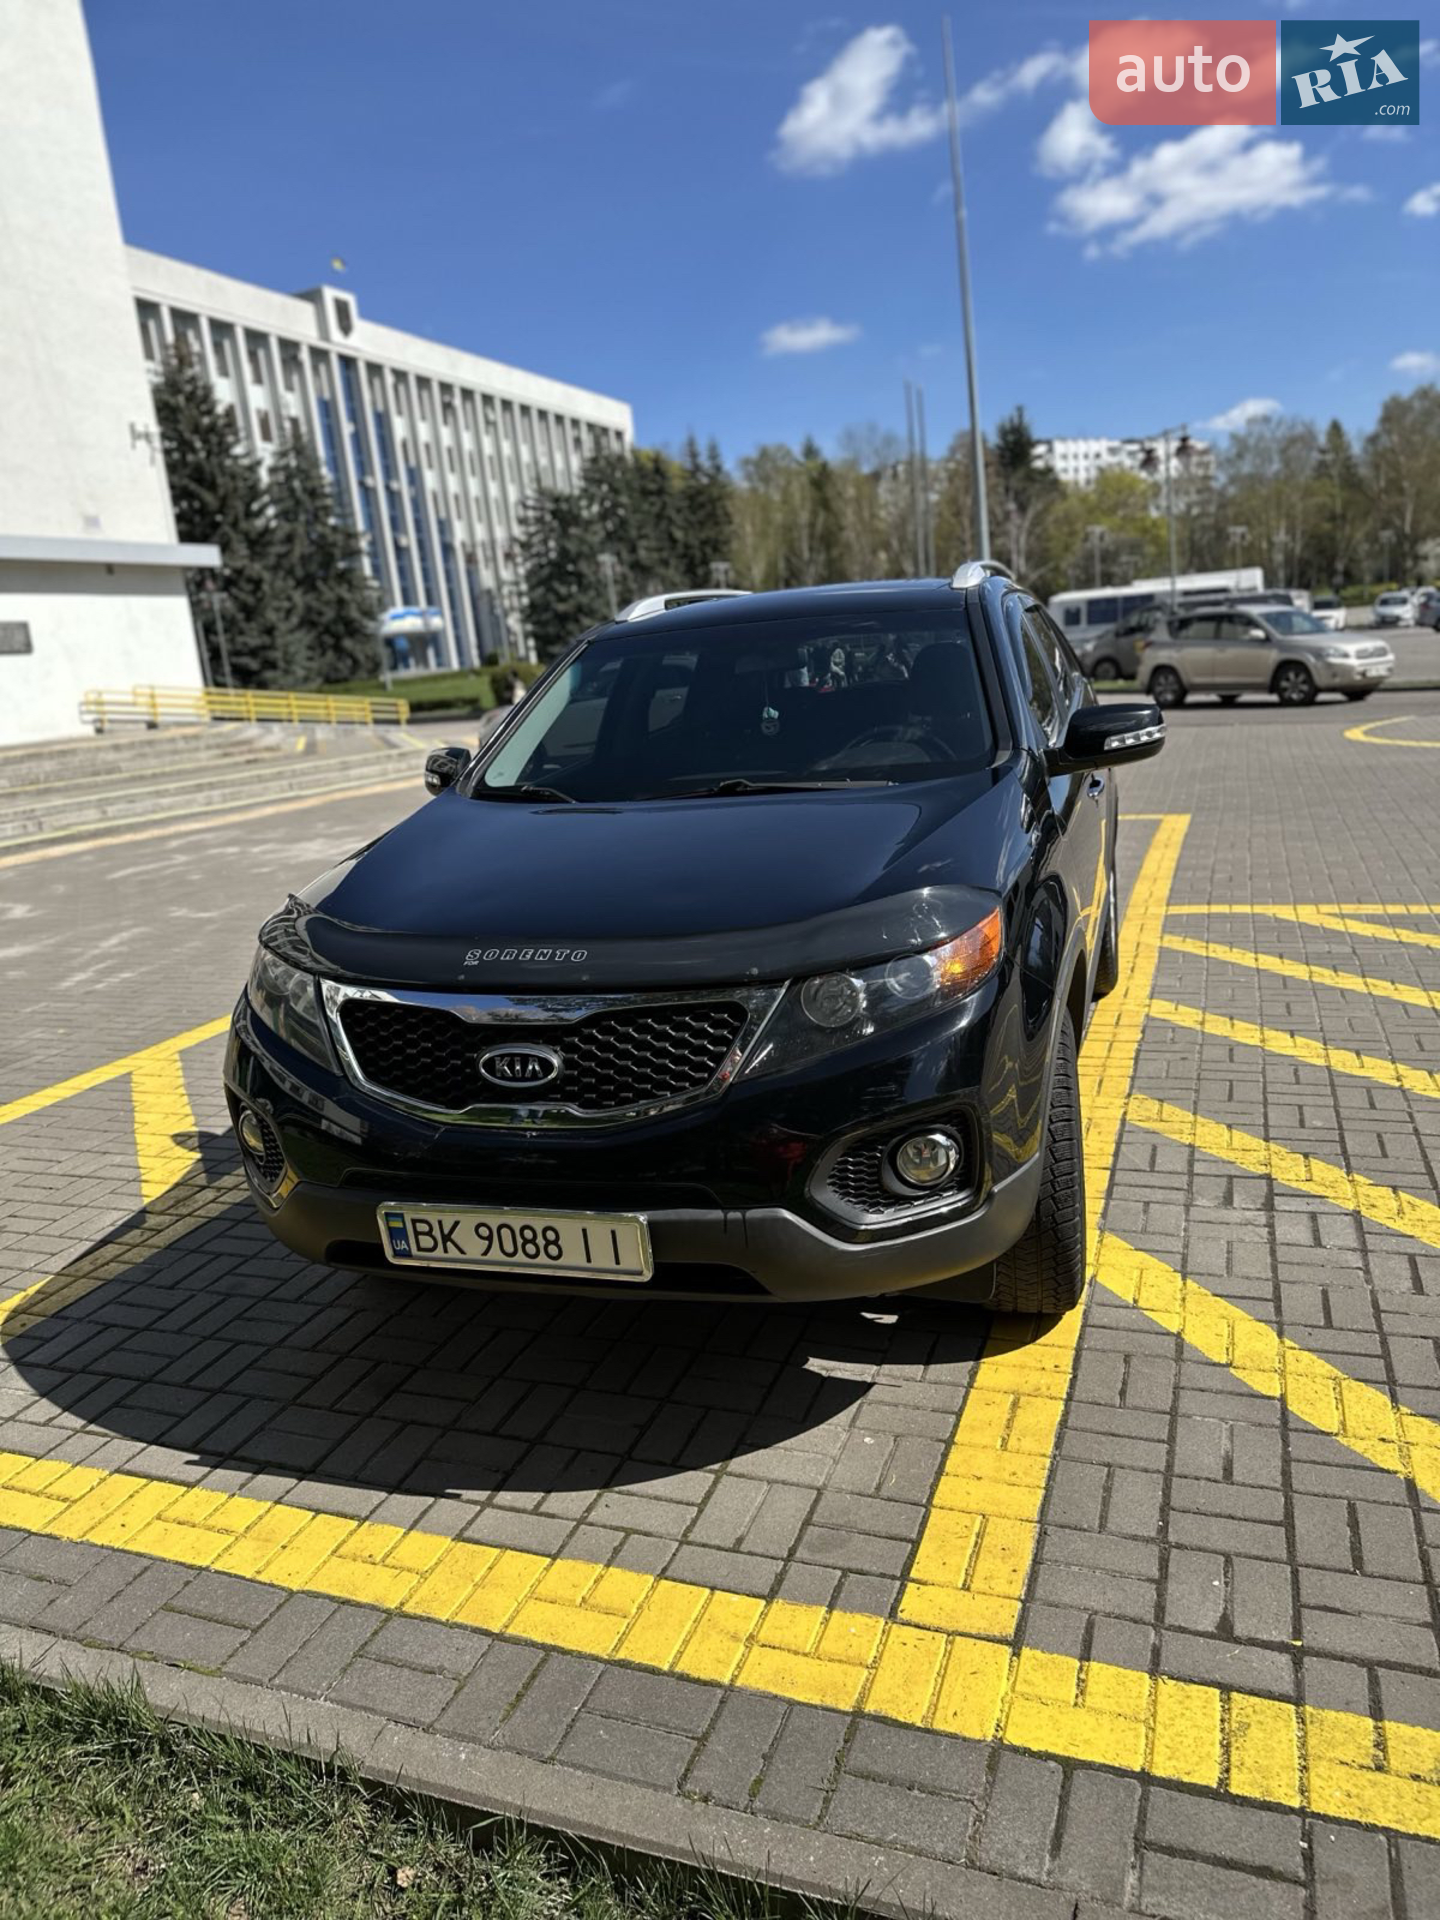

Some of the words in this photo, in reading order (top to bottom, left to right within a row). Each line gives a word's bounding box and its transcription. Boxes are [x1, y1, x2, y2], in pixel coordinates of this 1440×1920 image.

[465, 948, 588, 962] SORENTO
[494, 1056, 544, 1078] KIA
[392, 1239, 409, 1251] UA
[410, 1218, 467, 1255] BK
[473, 1222, 564, 1261] 9088
